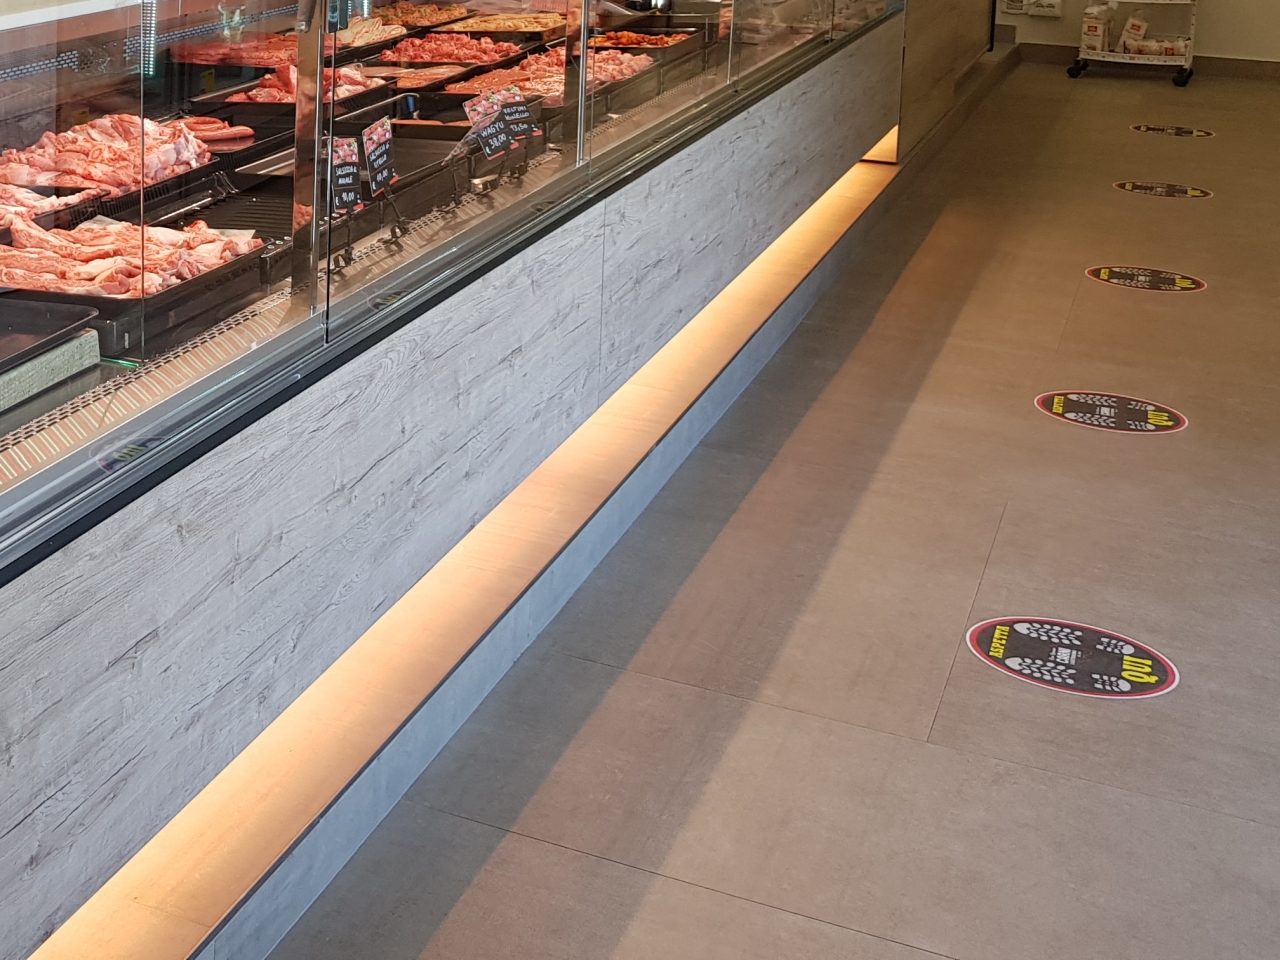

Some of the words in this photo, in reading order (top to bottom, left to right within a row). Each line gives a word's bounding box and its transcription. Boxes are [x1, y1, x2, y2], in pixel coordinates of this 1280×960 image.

[480, 121, 504, 138] WAGYU
[488, 133, 507, 149] 38,00
[988, 624, 1010, 659] ASPETTA
[1121, 655, 1160, 684] QUI
